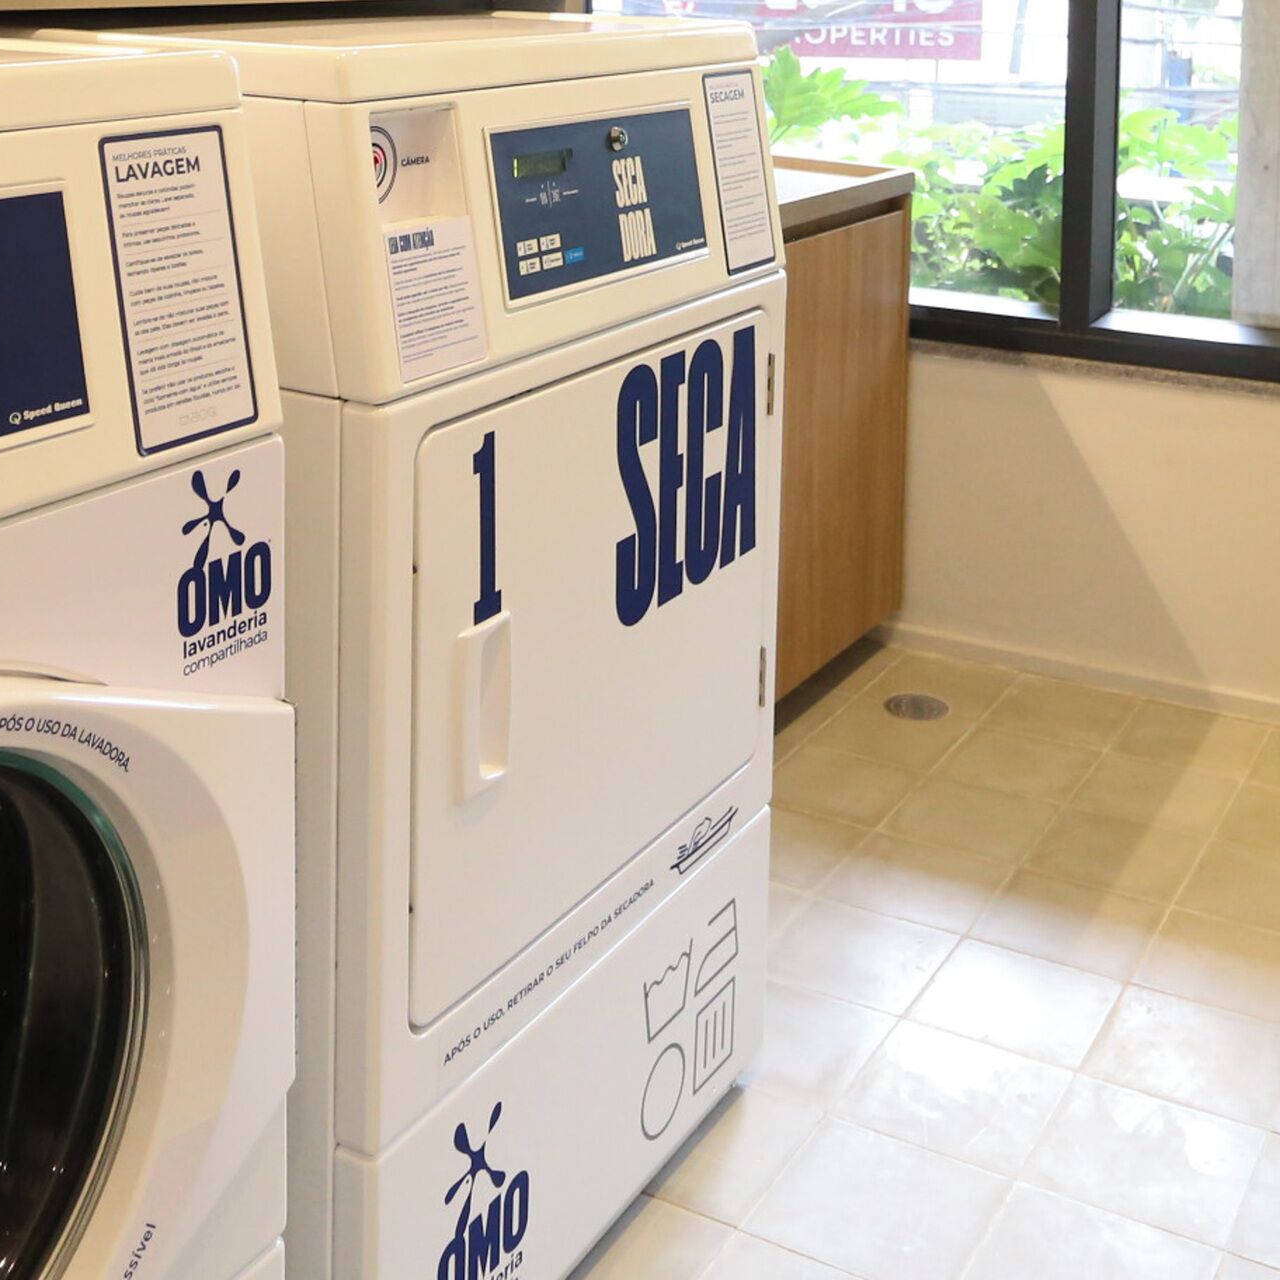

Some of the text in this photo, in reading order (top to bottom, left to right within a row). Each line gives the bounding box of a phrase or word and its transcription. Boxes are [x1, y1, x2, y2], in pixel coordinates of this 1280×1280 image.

[709, 89, 746, 105] SECAGEM
[112, 146, 187, 162] MELHORES PRÁTICAS
[115, 156, 201, 183] LAVAGEM
[612, 155, 648, 208] SECA
[618, 207, 657, 263] DORA
[23, 398, 83, 421] Speed Queen
[616, 325, 756, 627] SECA
[473, 431, 502, 626] 1
[178, 541, 271, 637] OMO
[183, 630, 268, 677] compartilhada
[184, 609, 267, 659] lavanderia
[24, 716, 36, 732] O
[36, 717, 62, 736] USO
[62, 721, 80, 742] DA
[78, 727, 131, 773] LAVADORA.
[443, 878, 655, 1067] APÓS O USO, RETIRAR O SEU FELPO DA SECADORA
